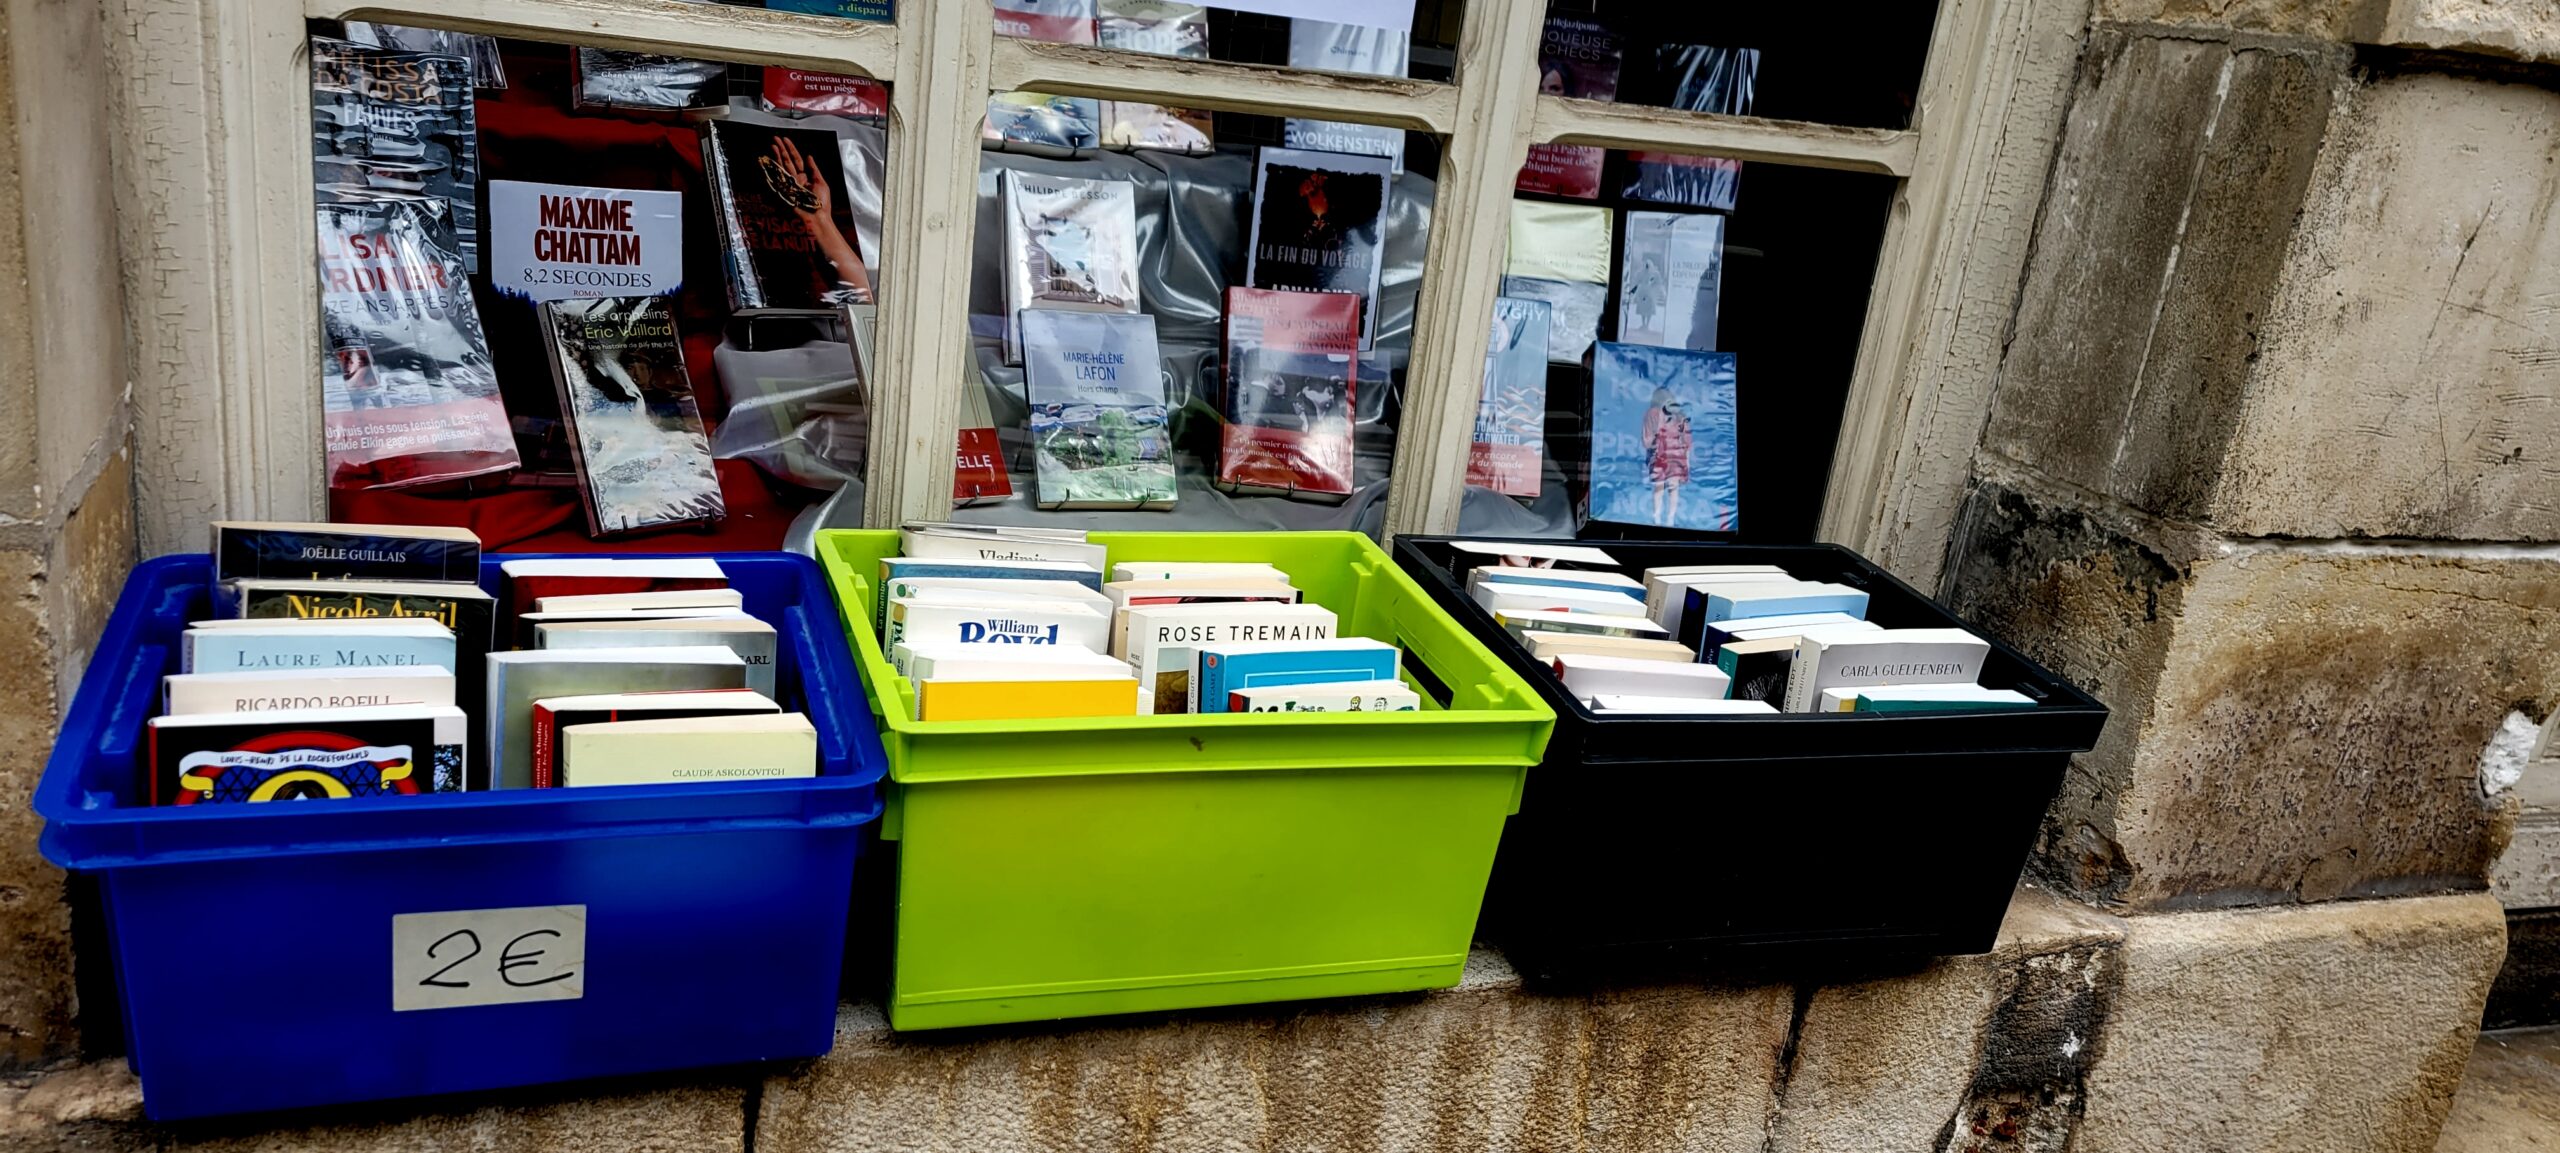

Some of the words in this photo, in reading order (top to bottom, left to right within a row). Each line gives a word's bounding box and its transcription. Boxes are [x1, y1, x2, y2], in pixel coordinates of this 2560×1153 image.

[838, 4, 844, 12] a
[847, 3, 888, 16] disparu
[1543, 43, 1601, 61] CHECS
[789, 71, 802, 81] Ce
[804, 74, 841, 84] nouveau
[843, 77, 871, 86] roman
[804, 83, 818, 91] est
[820, 84, 832, 92] un
[834, 84, 857, 94] piège
[1290, 130, 1398, 155] WOLKENSTEIN
[1537, 152, 1550, 162] au
[1551, 153, 1573, 166] bout
[540, 194, 634, 232] MAXIME
[319, 232, 398, 261] LISA
[534, 229, 641, 266] CHATTAM
[1260, 243, 1273, 261] LA
[1277, 245, 1298, 264] FIN
[1301, 247, 1318, 266] DU
[1321, 249, 1369, 270] VOYAGE
[523, 267, 548, 285] 8,2
[552, 269, 652, 288] SECONDES
[573, 289, 604, 298] ROMAN
[356, 299, 390, 314] ANS
[582, 311, 606, 323] Les
[609, 308, 670, 324] orphelins
[585, 323, 615, 340] Éric
[618, 322, 672, 338] Vuillard
[588, 343, 601, 351] Une
[602, 342, 628, 350] histoire
[651, 341, 662, 349] the
[1063, 350, 1126, 365] MARIE-HÉLÈNE
[1075, 365, 1117, 381] LAFON
[1078, 385, 1094, 393] Hors
[1095, 385, 1119, 395] champ
[364, 423, 385, 436] clos
[387, 421, 410, 435] sous
[360, 436, 384, 450] Elkin
[386, 434, 415, 449] gagne
[417, 432, 430, 445] en
[1252, 440, 1281, 449] premier
[955, 454, 993, 469] ELLE
[1249, 448, 1274, 459] monde
[1275, 451, 1287, 460] est
[1484, 451, 1517, 461] encore
[1477, 458, 1490, 468] du
[1491, 460, 1525, 470] monde
[301, 546, 347, 560] JOËLLE
[350, 550, 406, 563] GUILLAIS
[979, 549, 1048, 562] Vladii
[287, 594, 379, 618] Nicole
[987, 619, 1039, 634] William
[1158, 626, 1217, 642] ROSE
[1229, 625, 1327, 641] TREMAIN
[238, 650, 321, 667] LAURE
[336, 650, 421, 667] MANEL
[1841, 665, 1879, 678] CARLA
[1882, 663, 1964, 677] GUELFENBEIN
[236, 697, 323, 712] RICARDO
[280, 754, 290, 763] DE
[293, 753, 303, 763] LA
[672, 769, 713, 778] CLAUDE
[715, 768, 785, 777] ASKOLOVITCH
